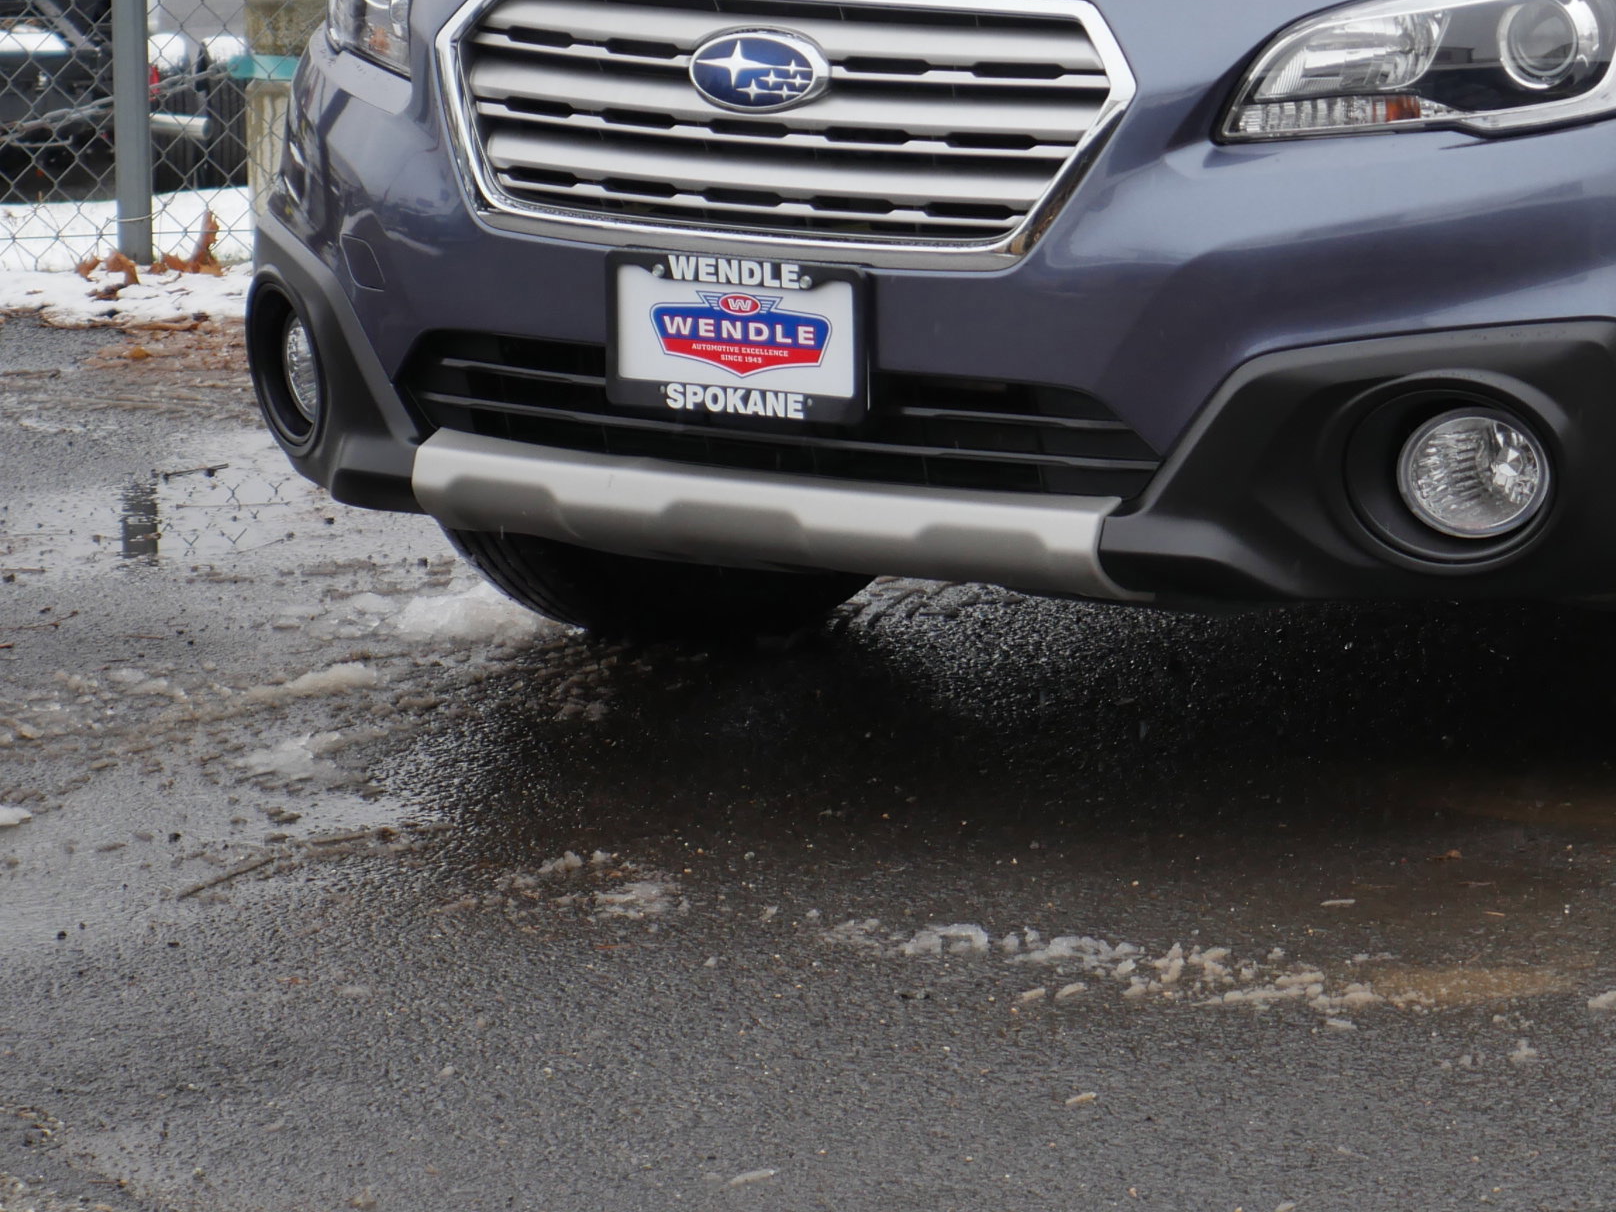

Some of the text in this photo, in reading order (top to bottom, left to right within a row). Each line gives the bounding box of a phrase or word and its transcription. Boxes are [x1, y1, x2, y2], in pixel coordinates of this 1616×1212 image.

[667, 255, 800, 289] WENDLE
[662, 315, 816, 345] WENDLE
[691, 343, 789, 357] AUTOMOTIVE EXCELLENCE
[720, 354, 743, 363] SINCE
[666, 383, 804, 420] SPOKANE
